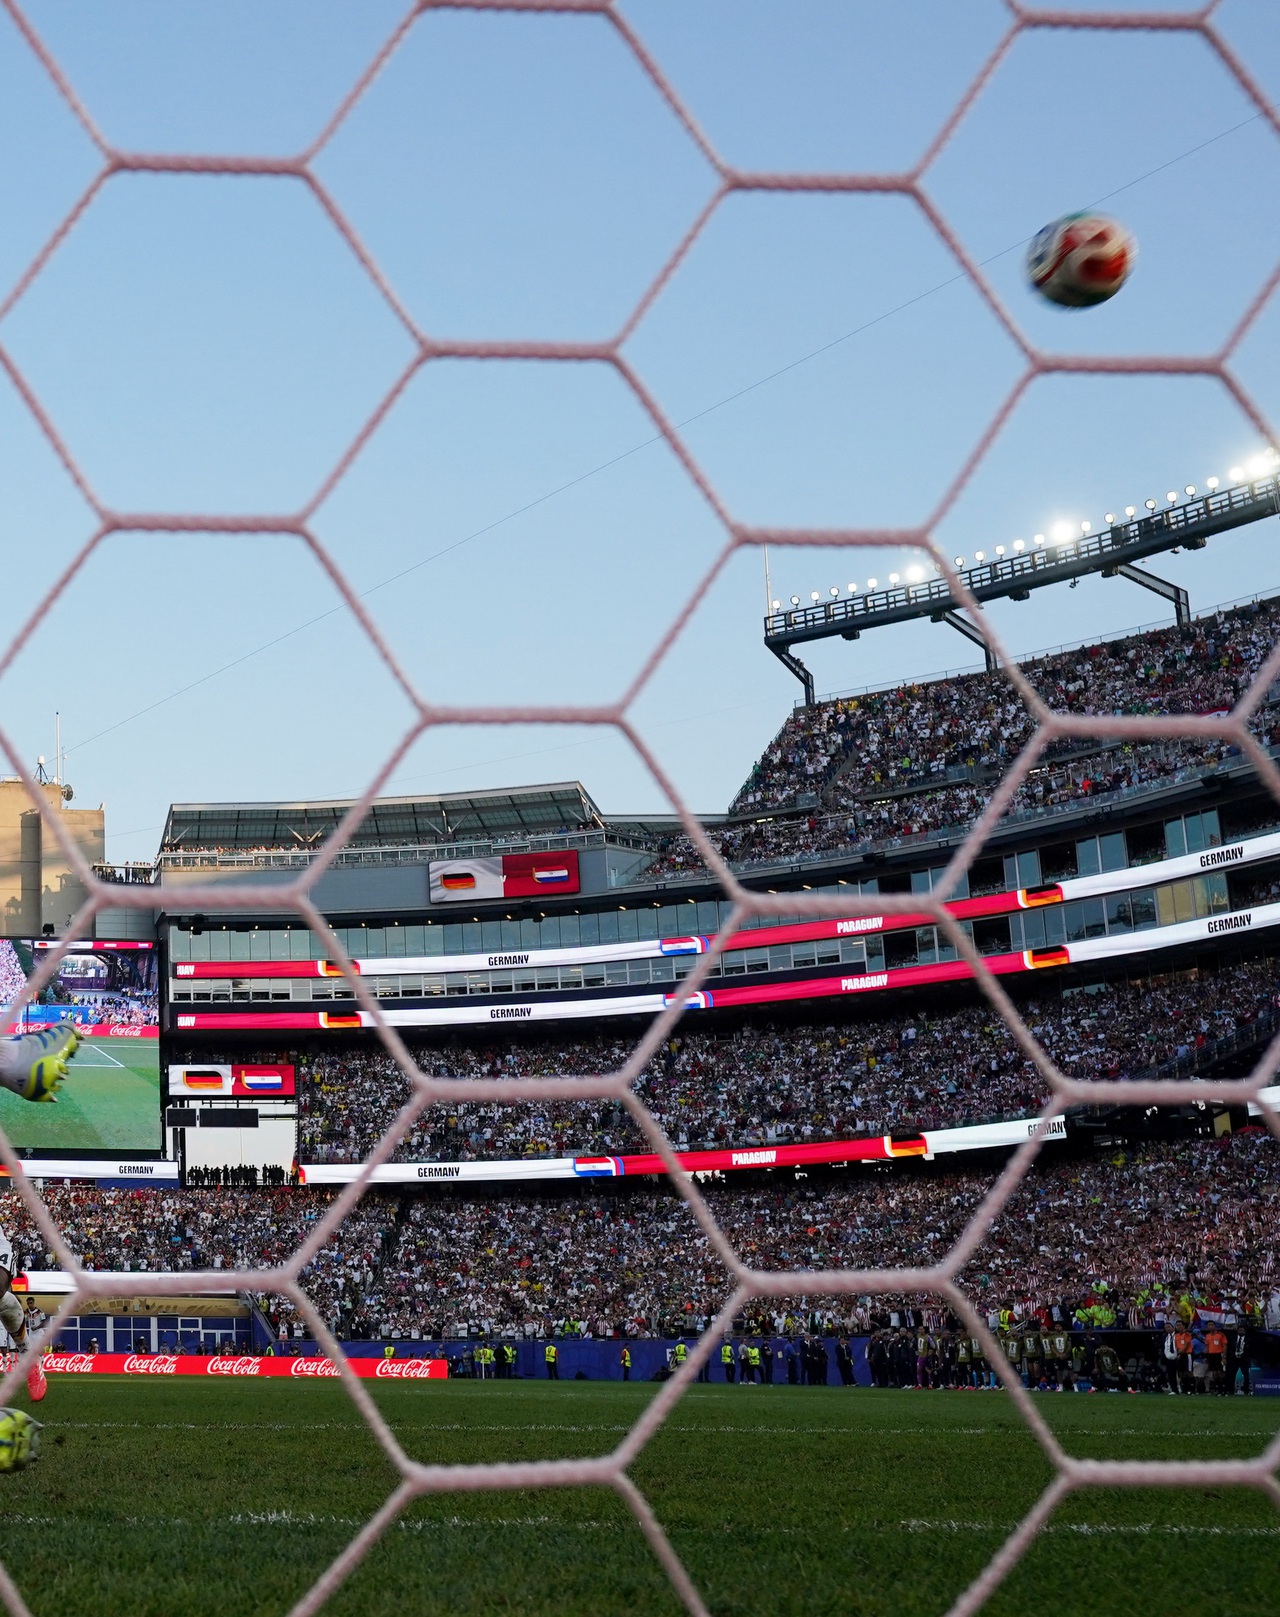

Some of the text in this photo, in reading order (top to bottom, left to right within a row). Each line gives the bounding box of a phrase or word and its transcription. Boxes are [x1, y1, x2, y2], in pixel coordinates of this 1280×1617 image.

[1199, 846, 1244, 868] GERMANY
[837, 916, 883, 934] PARAGUAY
[1207, 913, 1252, 934] GERMANY
[488, 954, 529, 967] GERMANY
[841, 973, 888, 991] PARAGUAY
[490, 1007, 532, 1019] GERMANY
[110, 1024, 141, 1036] Coca-Cola
[731, 1150, 776, 1167] PARAGUAY
[119, 1165, 154, 1175] GERMANY
[418, 1166, 460, 1178] GERMANY
[42, 1353, 96, 1373] Coca-Cola
[123, 1355, 178, 1374] Coca-Cola
[206, 1356, 262, 1375] Coca-Cola
[375, 1359, 432, 1378] Coca-Cola
